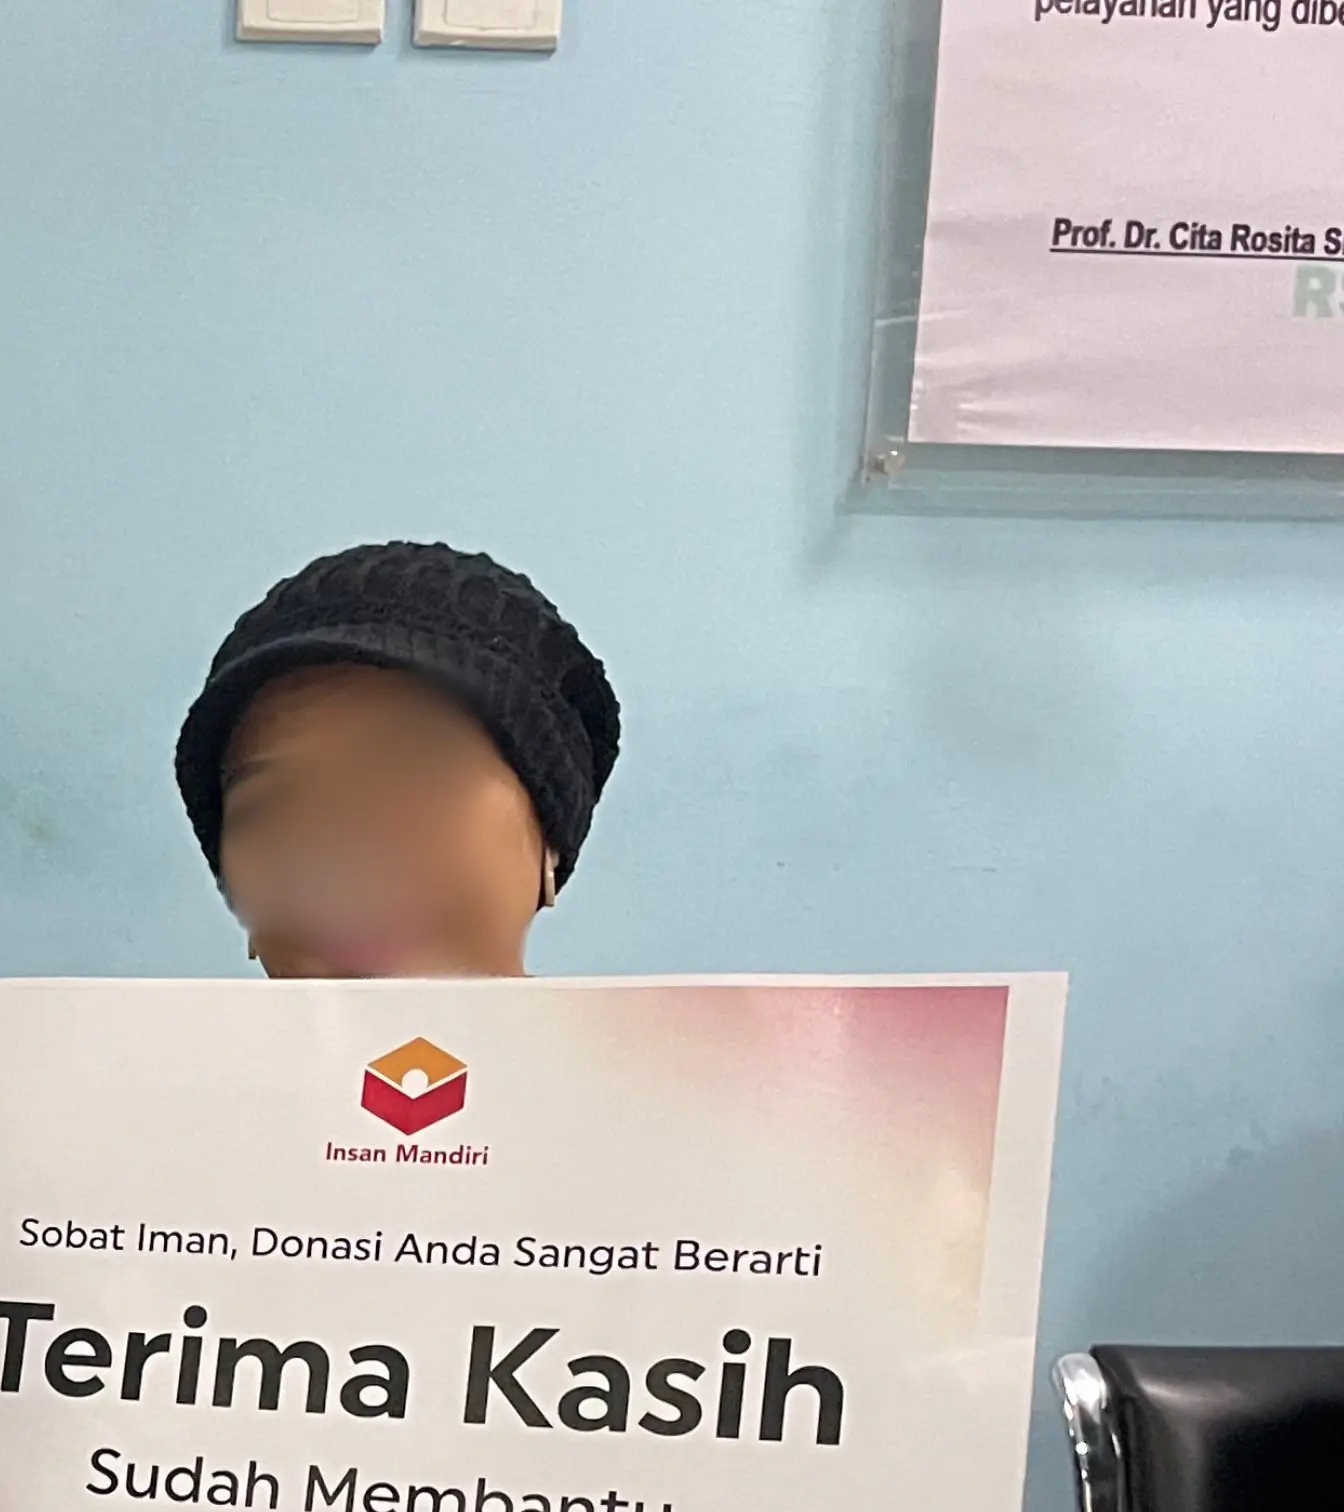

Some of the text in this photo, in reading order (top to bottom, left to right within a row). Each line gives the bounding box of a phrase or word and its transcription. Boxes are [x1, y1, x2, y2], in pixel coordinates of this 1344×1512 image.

[1205, 0, 1282, 32] yang
[1051, 217, 1344, 256] Prof. Dr. Cita Rosita S
[1292, 264, 1344, 319] R
[326, 1142, 489, 1165] Insan Mandiri
[20, 1218, 823, 1277] Sobat Iman, Donasi Anda Sangat Berarti
[462, 1325, 845, 1446] Kasih
[85, 1448, 279, 1509] Sudah
